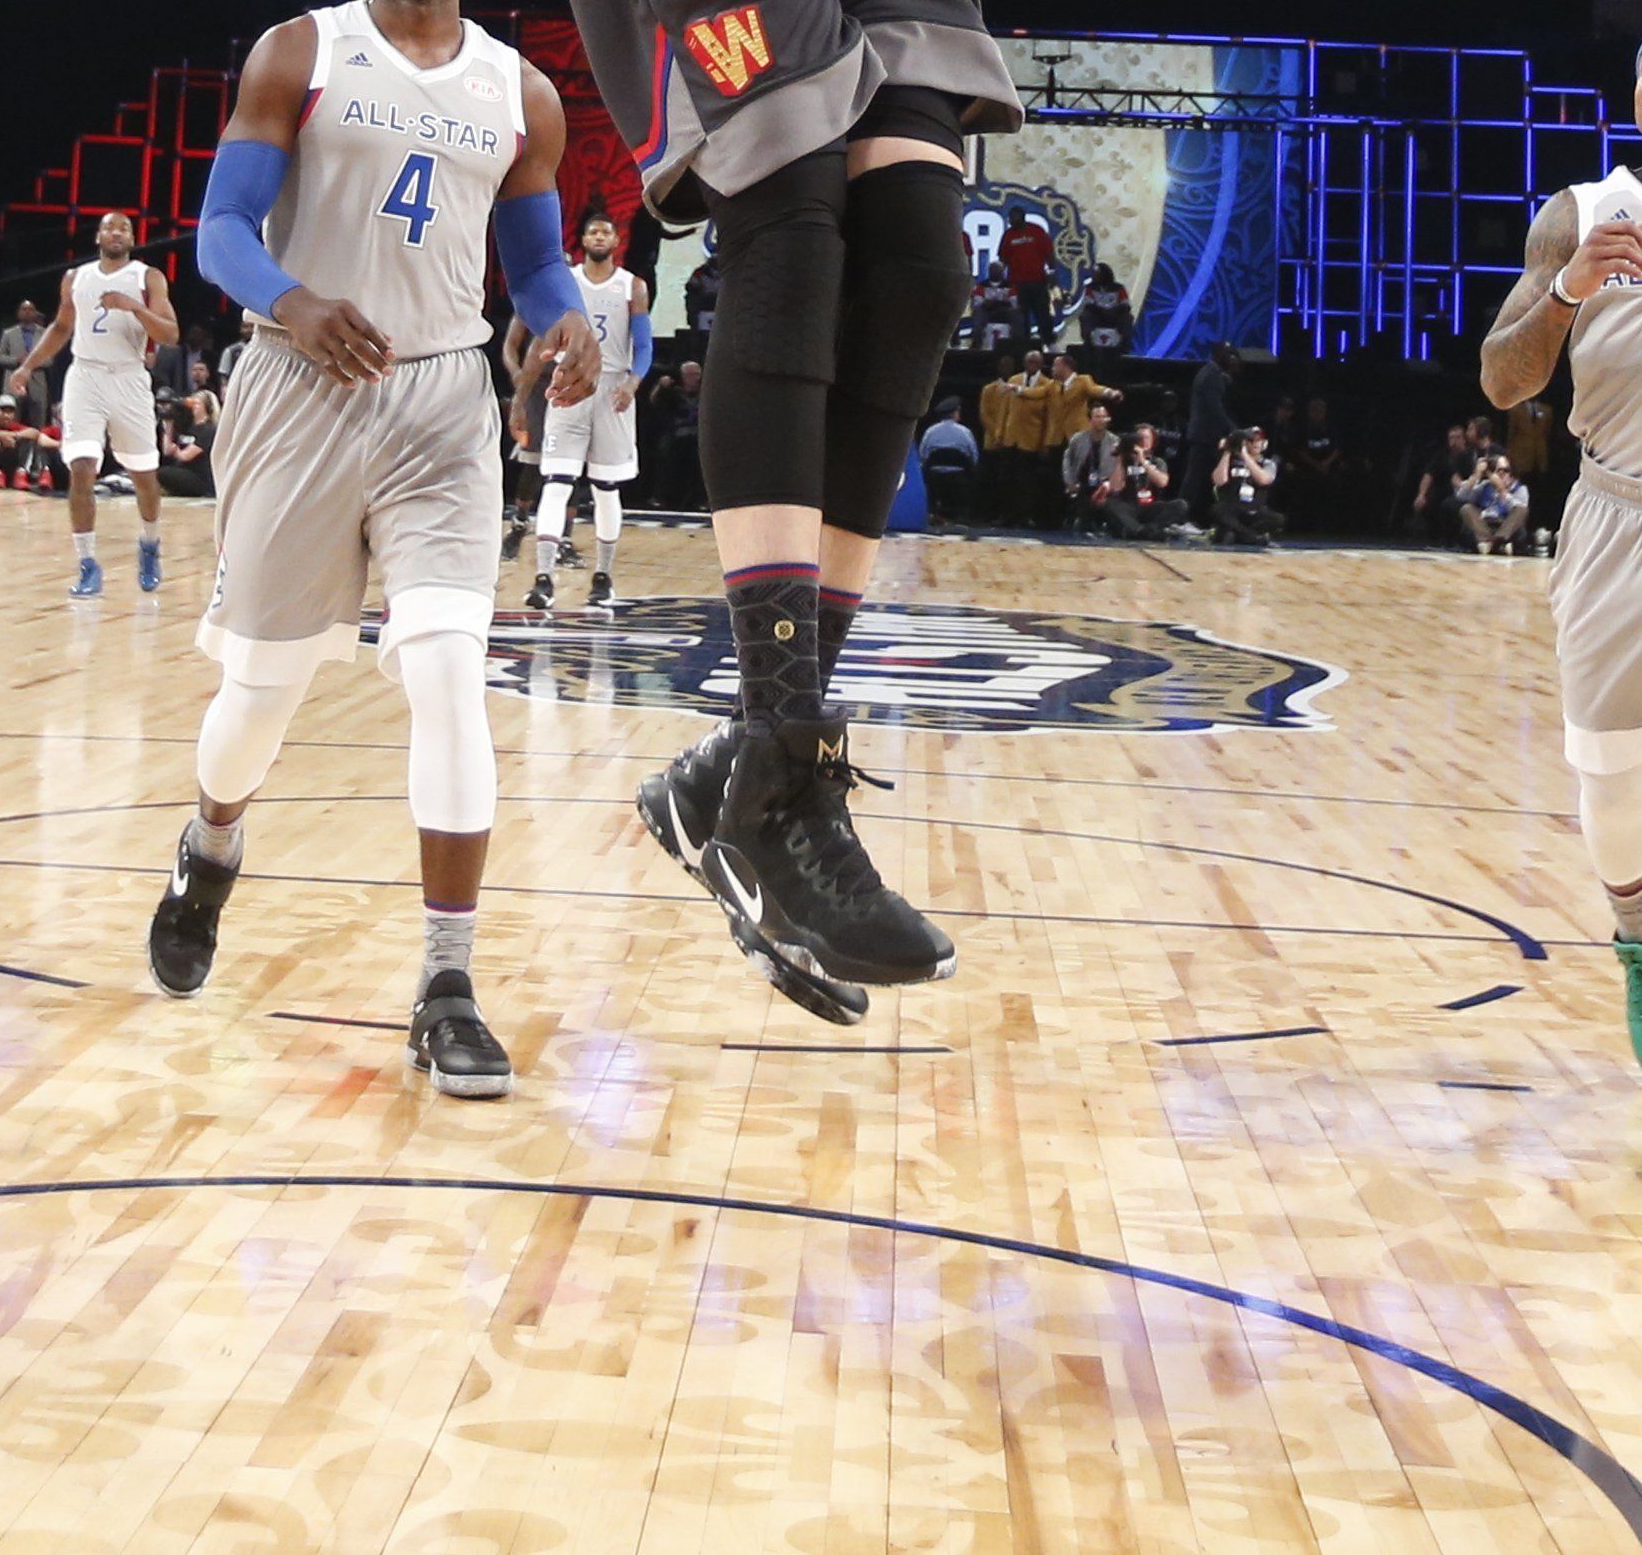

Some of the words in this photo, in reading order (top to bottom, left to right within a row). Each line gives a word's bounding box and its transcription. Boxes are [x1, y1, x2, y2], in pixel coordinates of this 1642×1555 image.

[377, 150, 440, 248] 4
[92, 304, 109, 334] 2
[593, 314, 608, 342] 3
